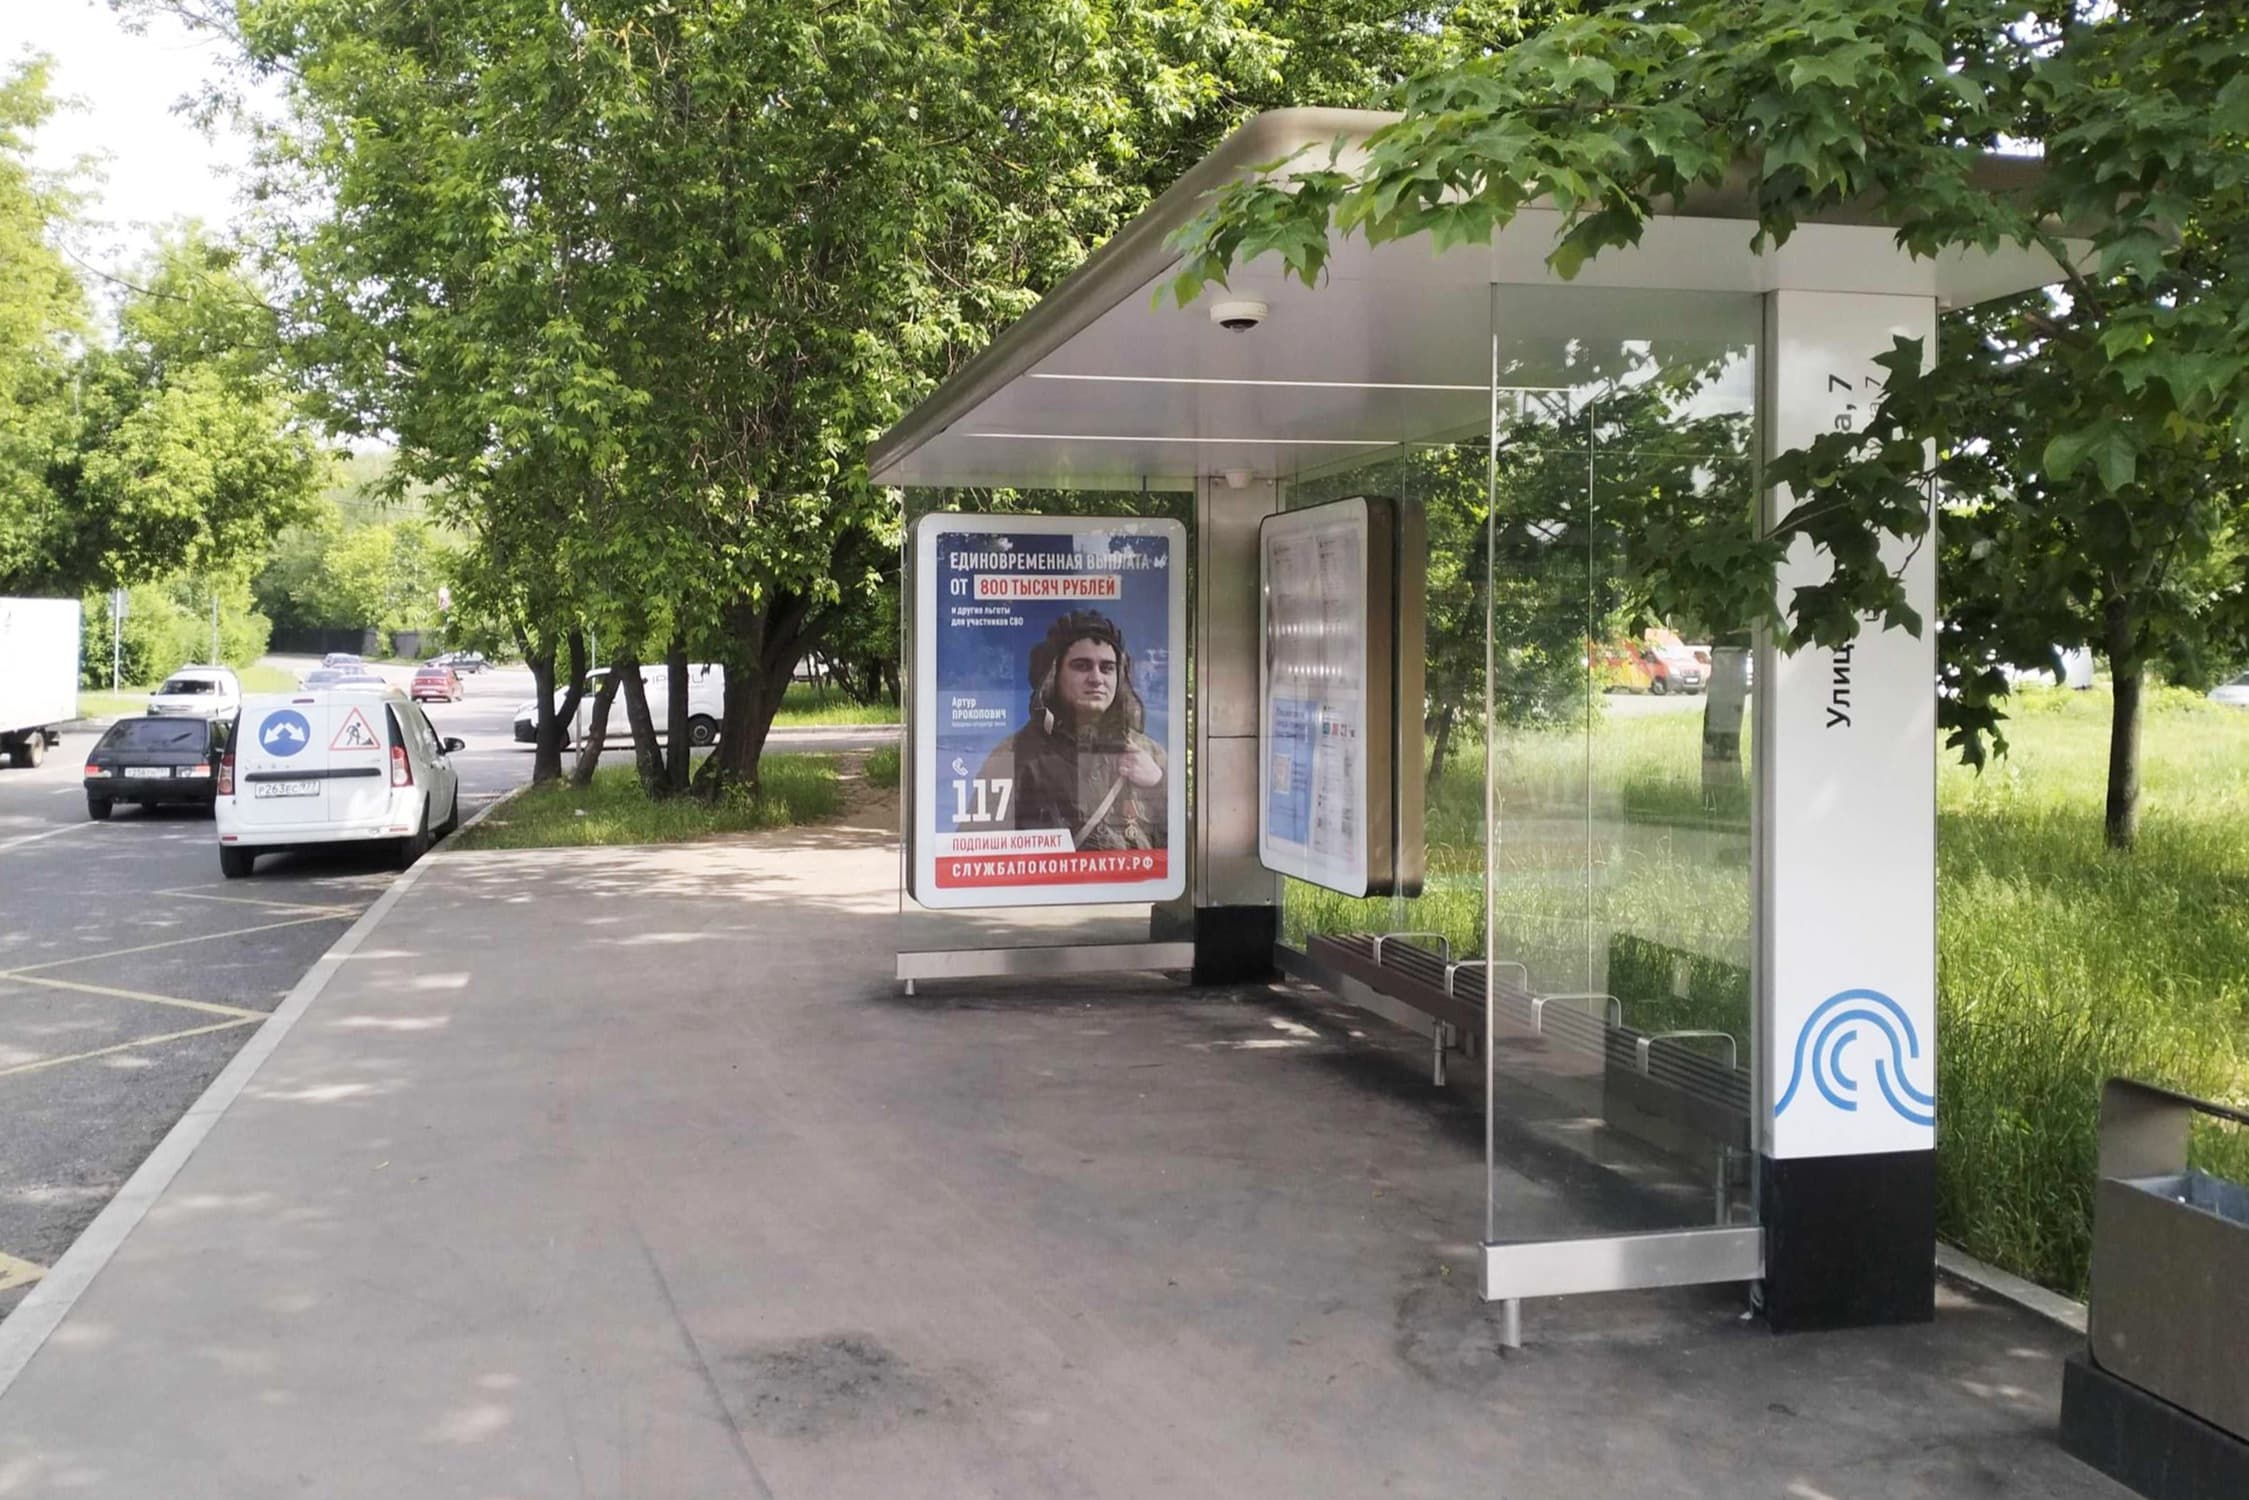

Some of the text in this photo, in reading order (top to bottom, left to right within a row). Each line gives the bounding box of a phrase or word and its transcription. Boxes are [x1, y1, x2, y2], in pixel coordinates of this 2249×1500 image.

[1828, 374, 1853, 393] 7
[950, 552, 1082, 571] ЕДИНОВРЕМЕННАЯ
[950, 575, 1116, 596] ОТ 800 ТЫСЯЧ РУБЛЕЙ
[1826, 644, 1854, 728] Улиц
[952, 696, 976, 709] Артур
[952, 709, 1007, 720] ПРОКОПОВИЧ
[952, 778, 1013, 823] 117
[952, 834, 1063, 852] ПОДПИШИ КОНТРАКТ
[951, 856, 1154, 878] СЛУЖБАПОКОНТРАКТУ.РФ
